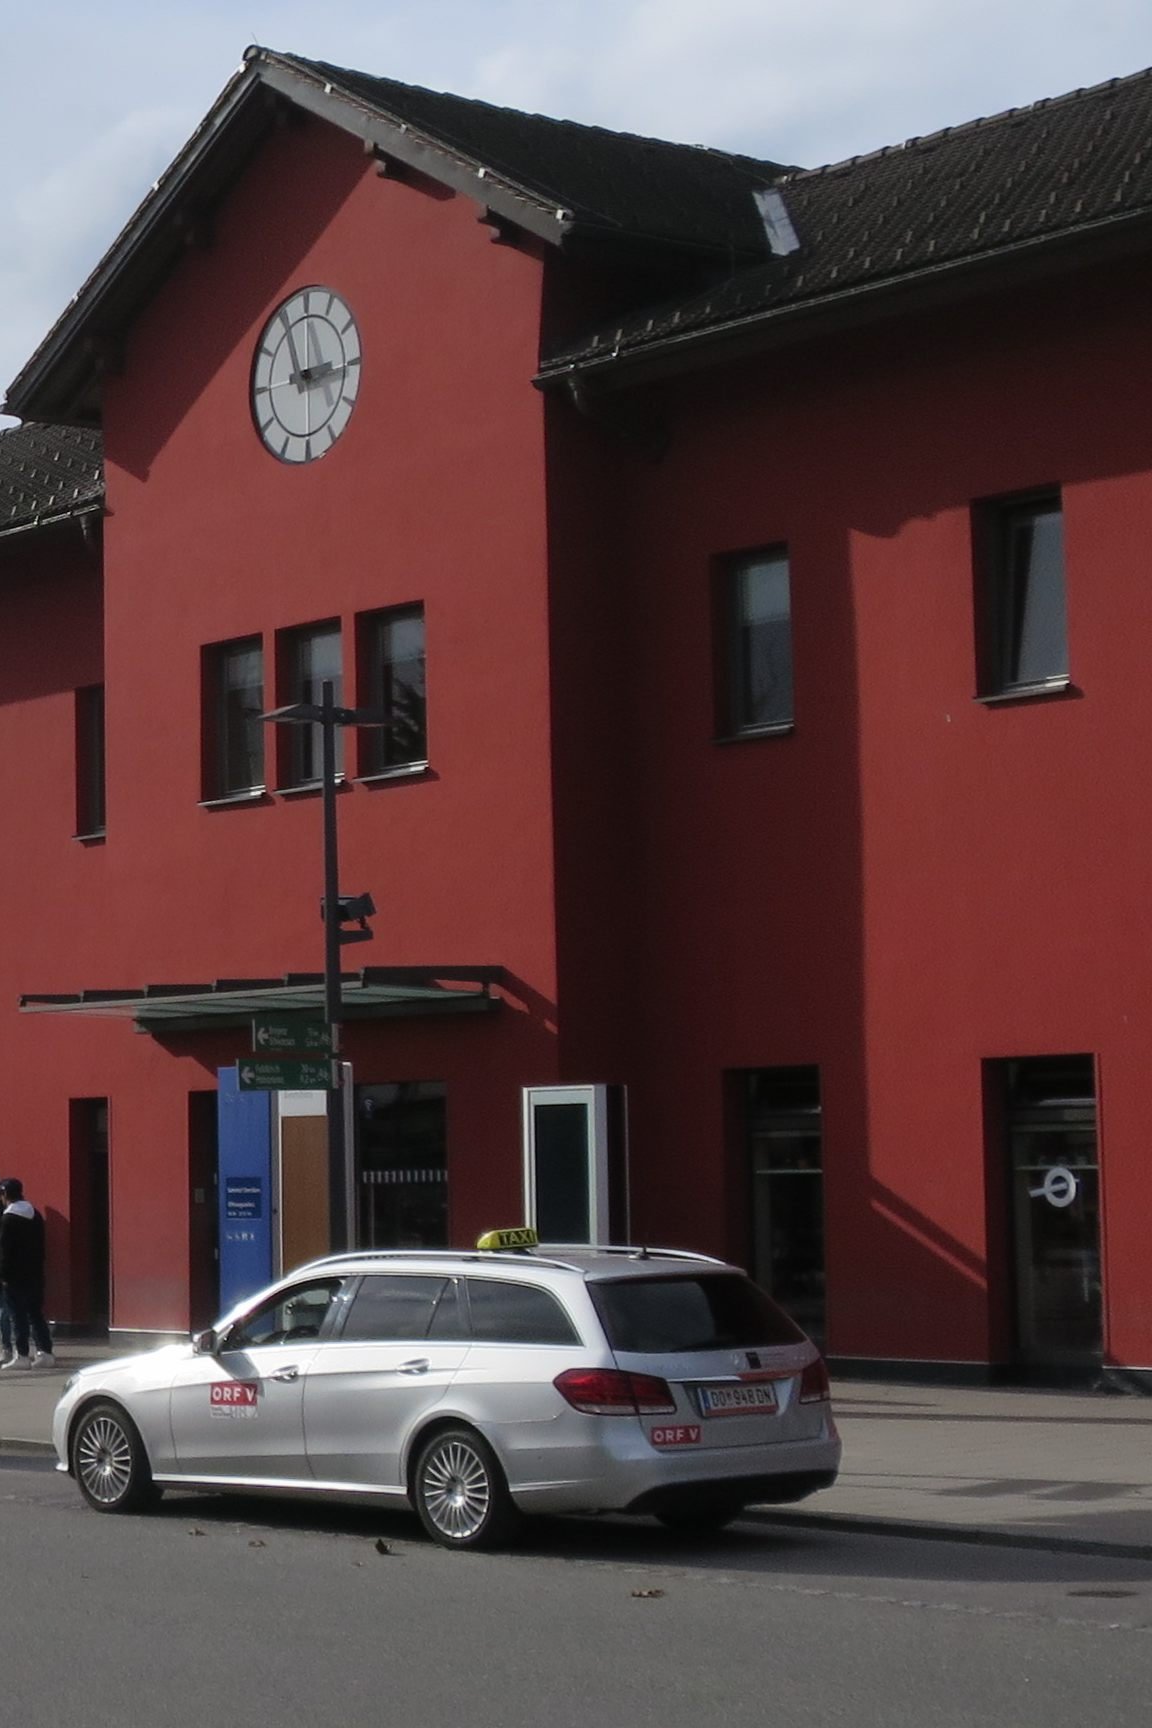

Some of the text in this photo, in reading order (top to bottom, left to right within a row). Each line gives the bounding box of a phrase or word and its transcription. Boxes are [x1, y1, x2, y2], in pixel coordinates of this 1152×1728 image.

[500, 1230, 535, 1246] TAXI
[212, 1387, 256, 1402] ORF V
[653, 1428, 699, 1443] ORF V
